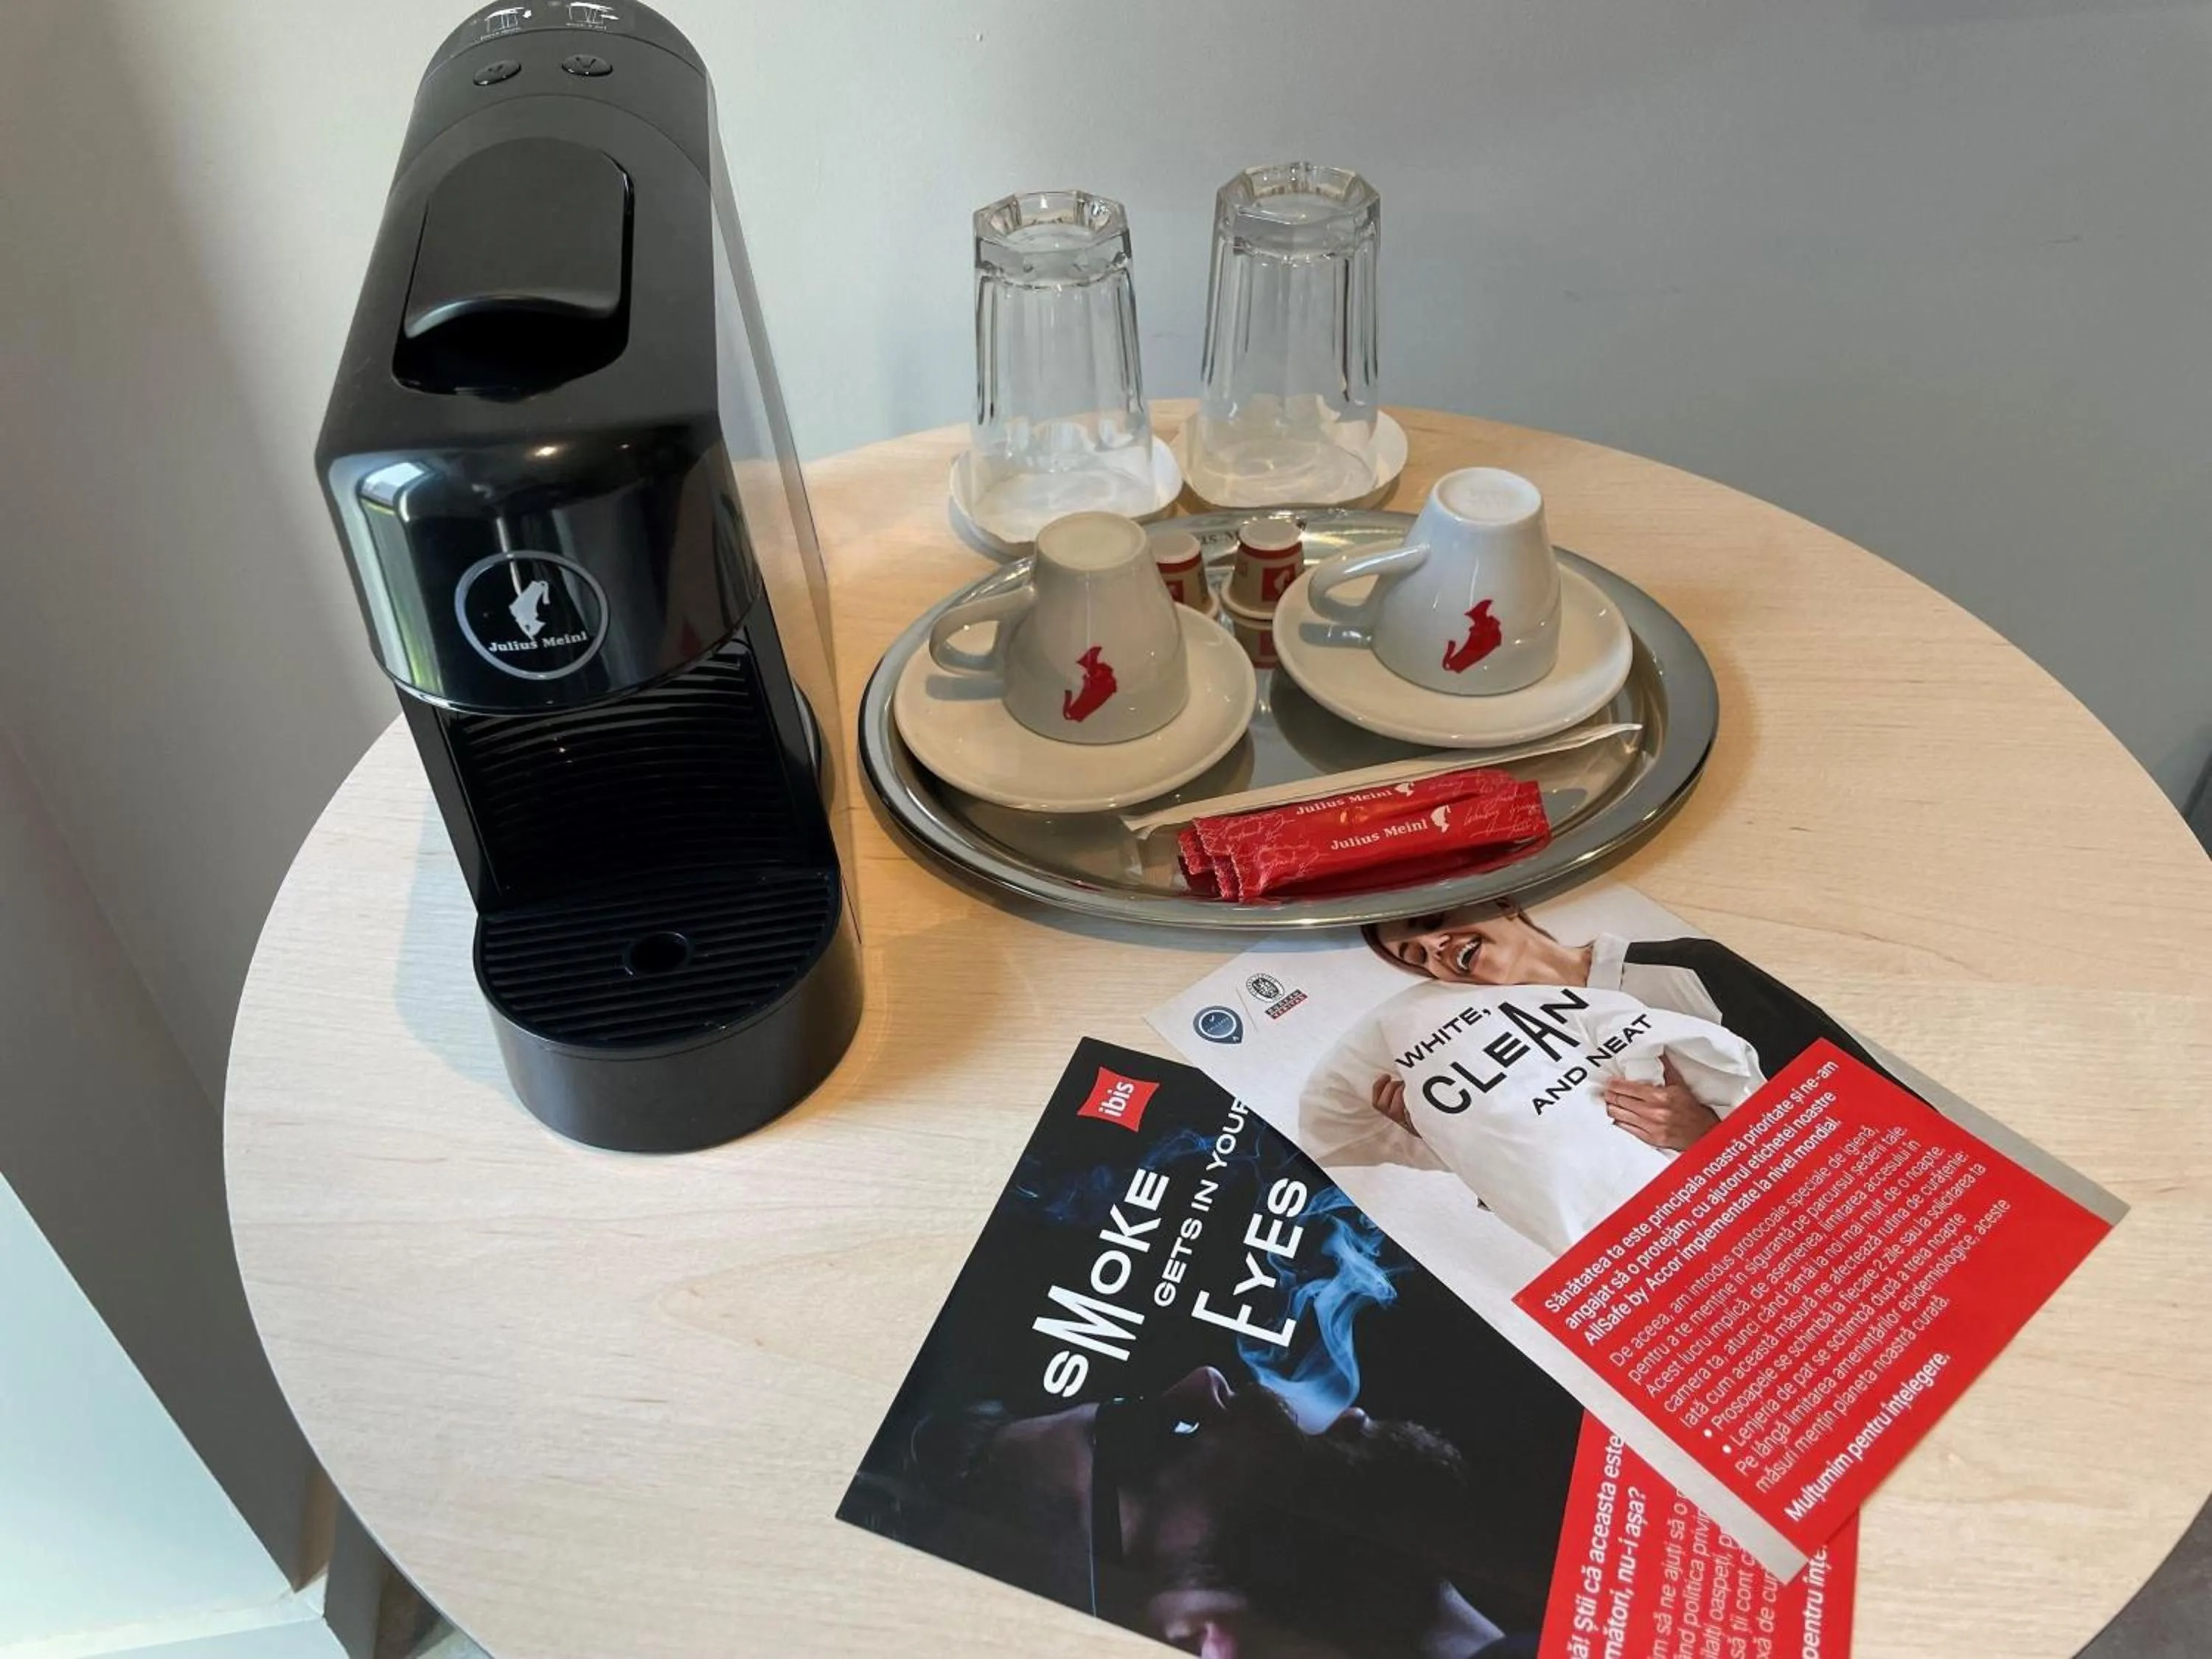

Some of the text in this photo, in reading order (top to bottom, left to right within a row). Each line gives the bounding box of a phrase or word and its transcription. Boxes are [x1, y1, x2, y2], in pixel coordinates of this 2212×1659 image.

[488, 631, 588, 652] Julius Meinl
[1296, 790, 1393, 815] Julius Meinl
[1330, 818, 1428, 850] Julius Meinl
[1395, 1006, 1492, 1068] WHITE,
[1422, 988, 1590, 1115] CLEAN
[1531, 1013, 1652, 1116] AND NEAT
[1097, 1081, 1135, 1118] ibis
[1545, 1061, 1839, 1313] Sănătatea ta este principala noastră prioritate și ne-am
[1565, 1092, 1837, 1329] angajat să o protejăm, cu ajutorul etichetei noastre
[1153, 1217, 1203, 1307] GETS
[1190, 1179, 1219, 1212] IN
[1584, 1116, 1841, 1346] AllSafe by Accor implementate la nivel mondial.
[1627, 1126, 1907, 1385] pentru a te menține în siguranță pe parcursul șederii tale.
[1927, 1213, 1966, 1250] noapte
[1190, 1178, 1308, 1348] EYES
[1608, 1346, 1634, 1367] De
[1630, 1313, 1675, 1349] aceea,
[1669, 1293, 1693, 1314] am
[1688, 1254, 1735, 1297] introdus
[1731, 1205, 1790, 1261] protocoale
[1786, 1167, 1832, 1208] speciale
[1828, 1152, 1847, 1169] de
[1645, 1139, 1921, 1399] Acest lucru implică, de asemenea, limitarea accesului în
[1896, 1270, 1910, 1281] a
[1902, 1247, 1933, 1273] treia
[1663, 1367, 1711, 1413] camera
[1705, 1354, 1729, 1369] ta,
[1723, 1320, 1761, 1356] atunci
[1757, 1291, 1790, 1324] când
[1810, 1256, 1829, 1269] la
[1824, 1237, 1846, 1259] noi
[1840, 1221, 1865, 1244] mai
[1860, 1198, 1888, 1225] mult
[1883, 1186, 1902, 1203] de
[1897, 1178, 1910, 1189] o
[1679, 1151, 1969, 1428] Iată cum această măsură ne afectează rutina de curățenie:
[1710, 1163, 1986, 1431] Prosoapele se schimbă la fiecare 2 zile sau la solicitarea ta
[1871, 1276, 1902, 1307] după
[1734, 1455, 1759, 1476] Pe
[1782, 1377, 1837, 1425] limitarea
[1973, 1200, 2011, 1236] aceste
[1826, 1301, 1877, 1352] schimbă
[1792, 1362, 1818, 1388] pat
[1812, 1349, 1832, 1366] se
[1756, 1445, 1799, 1493] măsuri
[1794, 1410, 1839, 1453] mențin
[1832, 1369, 1878, 1416] planeta
[1872, 1326, 1917, 1372] noastră
[1776, 1382, 1798, 1402] de
[1604, 1436, 1629, 1478] este
[1784, 1353, 1950, 1522] Mulțumim pentru înțelegere.
[1589, 1481, 1617, 1564] aceasta
[1624, 1486, 1648, 1538] așa?
[1668, 1519, 1686, 1540] să
[1673, 1503, 1688, 1516] o
[1580, 1565, 1602, 1594] că
[1617, 1537, 1639, 1584] nu-i
[1661, 1543, 1686, 1582] ajuți
[1660, 1584, 1676, 1609] ne
[1682, 1559, 1705, 1629] politica
[1709, 1552, 1735, 1622] oaspeți,
[1736, 1568, 1754, 1613] cont
[1653, 1612, 1672, 1635] să
[1756, 1607, 1775, 1633] de
[1801, 1589, 1824, 1659] pentru
